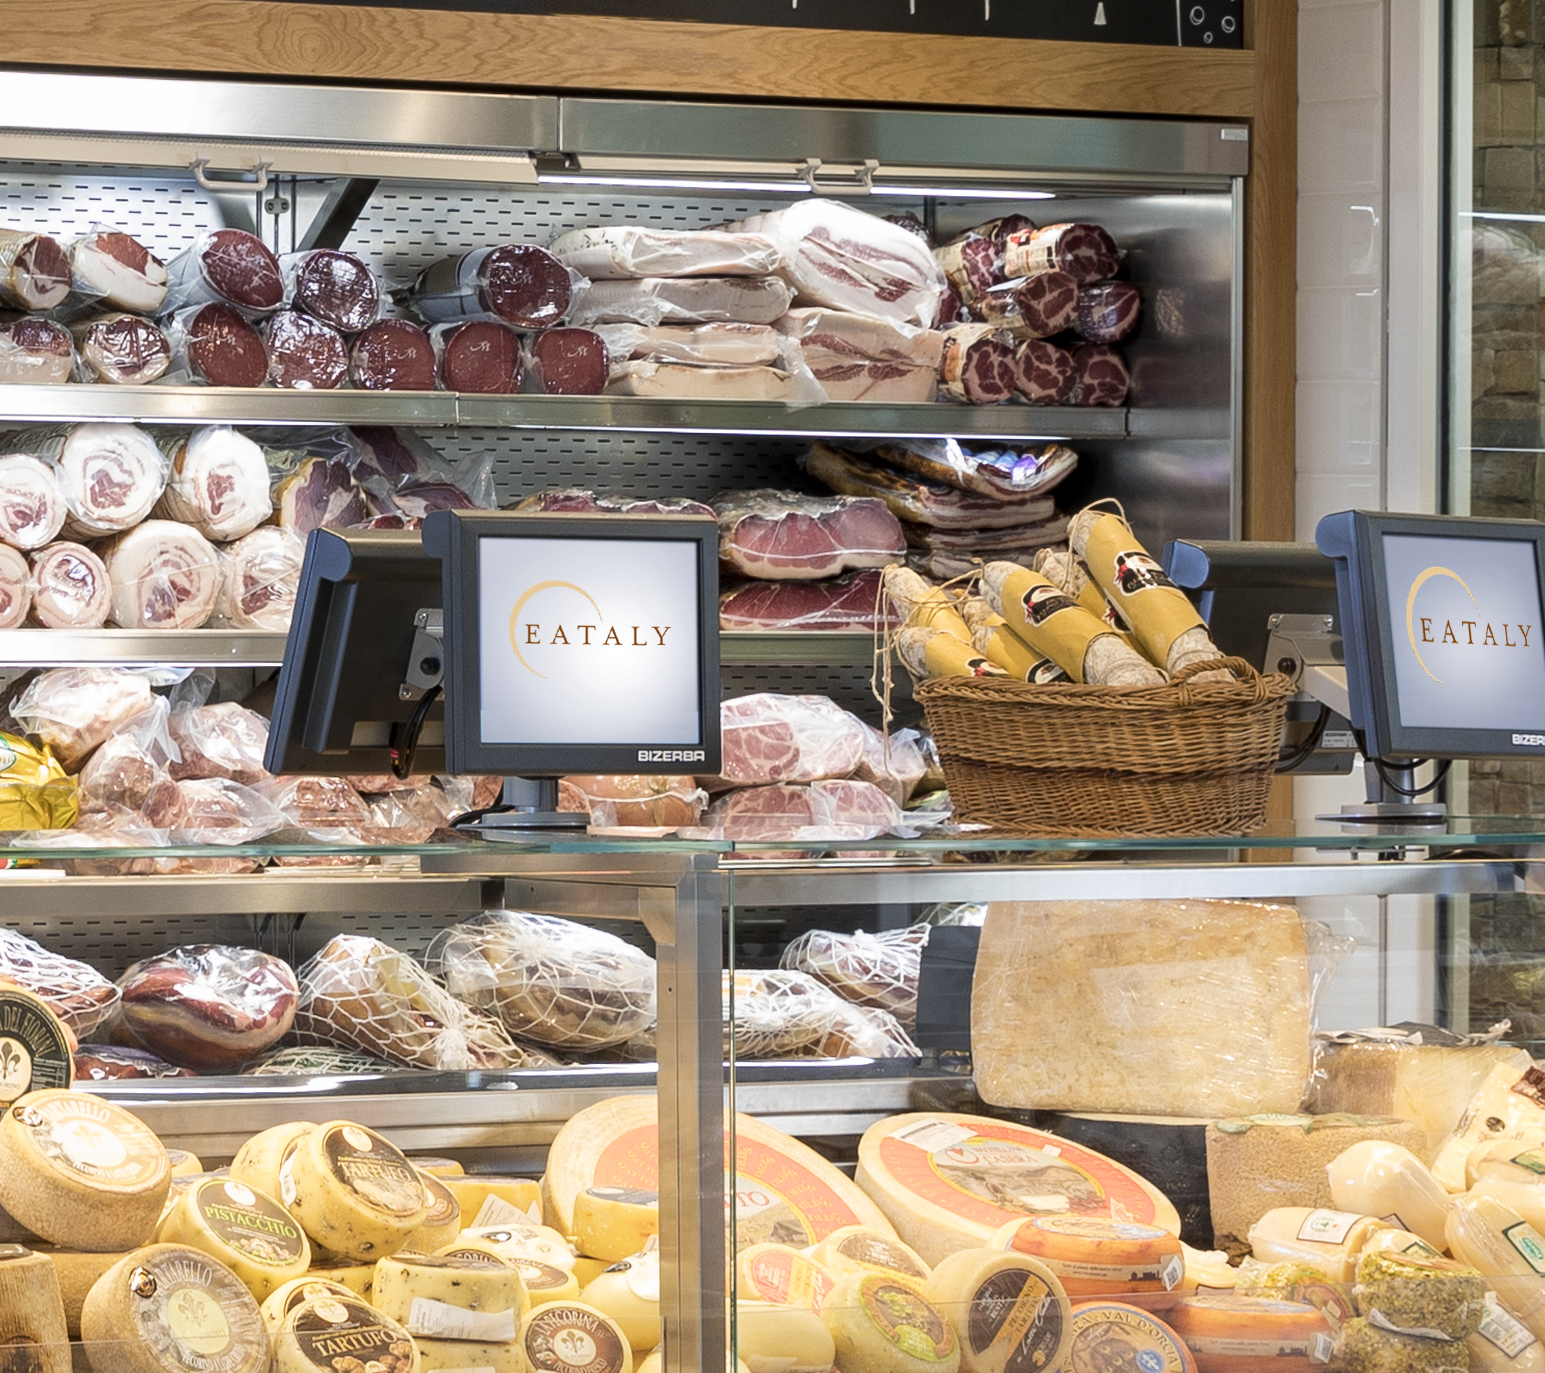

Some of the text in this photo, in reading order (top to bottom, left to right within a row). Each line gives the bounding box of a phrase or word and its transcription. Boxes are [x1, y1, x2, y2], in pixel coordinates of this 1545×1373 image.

[525, 623, 671, 647] EATALY
[1420, 617, 1532, 650] EATALY
[638, 750, 705, 762] BIZERBA
[4, 1005, 23, 1033] DEL
[21, 1013, 56, 1058] FIORINI
[338, 1161, 412, 1183] TARTUFO
[204, 1205, 298, 1240] PISTACCHIO
[543, 1309, 599, 1334] PECORINA
[311, 1329, 399, 1357] TARTUFO
[1101, 1310, 1181, 1367] VAL D'ORCIA
